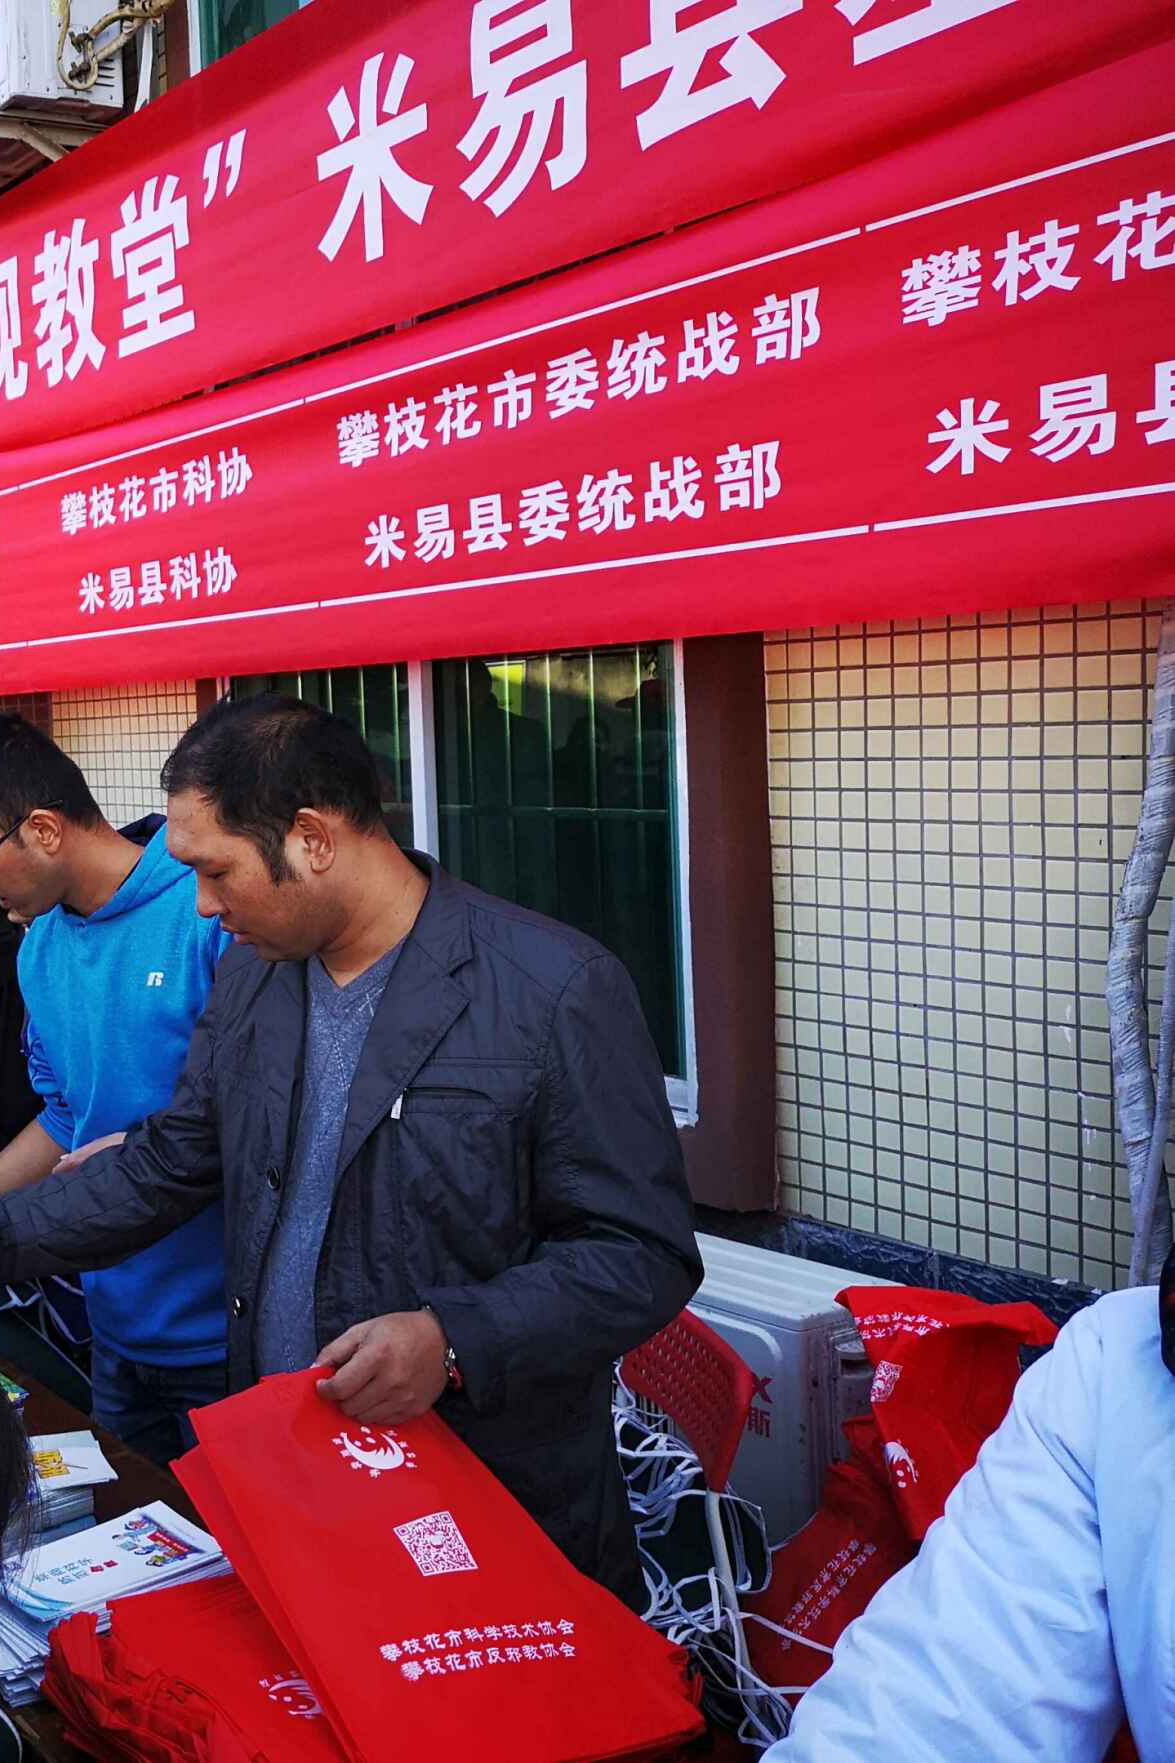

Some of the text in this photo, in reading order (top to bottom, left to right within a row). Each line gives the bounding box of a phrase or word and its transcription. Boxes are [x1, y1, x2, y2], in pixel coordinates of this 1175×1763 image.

[61, 447, 253, 536] 攀枝花市科协
[337, 287, 822, 468] 攀枝花市委统战部
[79, 546, 238, 615] 米易县科协
[365, 439, 782, 569] 米易县委统战部
[379, 1618, 576, 1662] 攀枝花市科学技术协会
[401, 1641, 576, 1681] 攀枝花市反邪教协会
